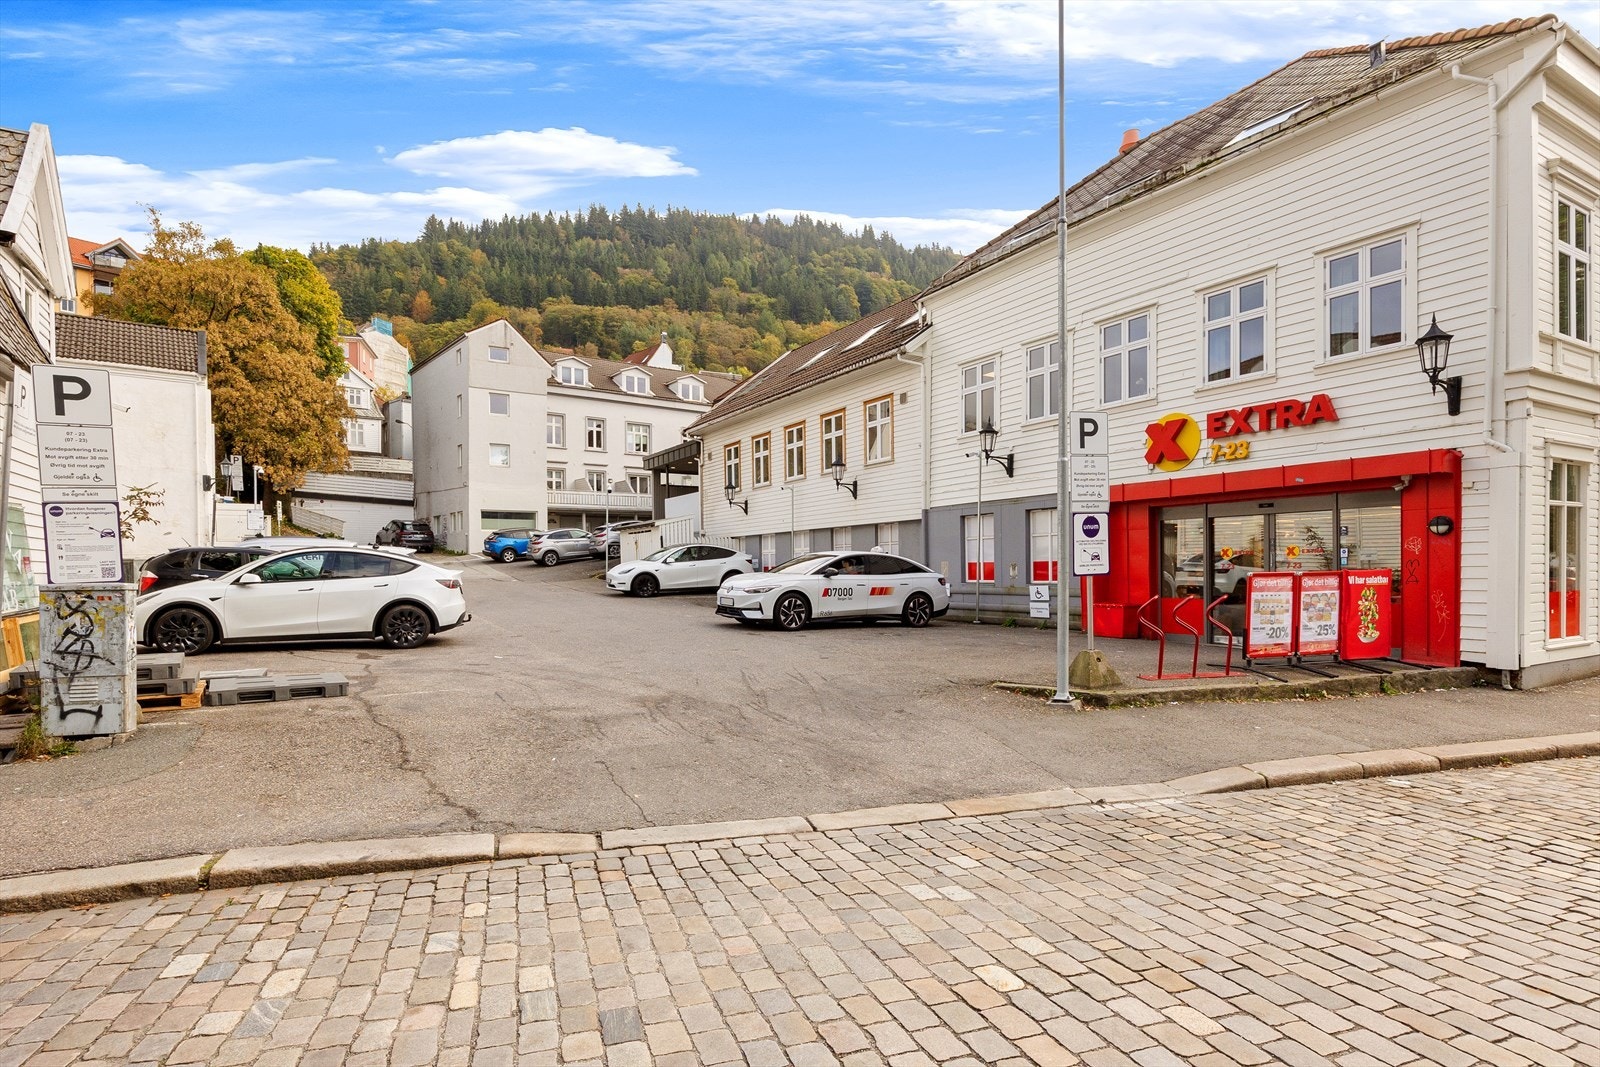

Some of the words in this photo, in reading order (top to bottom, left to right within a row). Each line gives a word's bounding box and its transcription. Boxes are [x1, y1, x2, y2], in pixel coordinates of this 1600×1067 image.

[53, 374, 91, 416] P
[1080, 418, 1098, 448] P
[1145, 418, 1190, 464] X
[1206, 394, 1339, 439] EXTRA
[1210, 440, 1250, 463] 7-23
[1348, 576, 1354, 584] Vi
[1355, 576, 1365, 584] har
[828, 588, 853, 597] 07000
[1266, 627, 1289, 639] -20%
[1315, 624, 1336, 636] -25%
